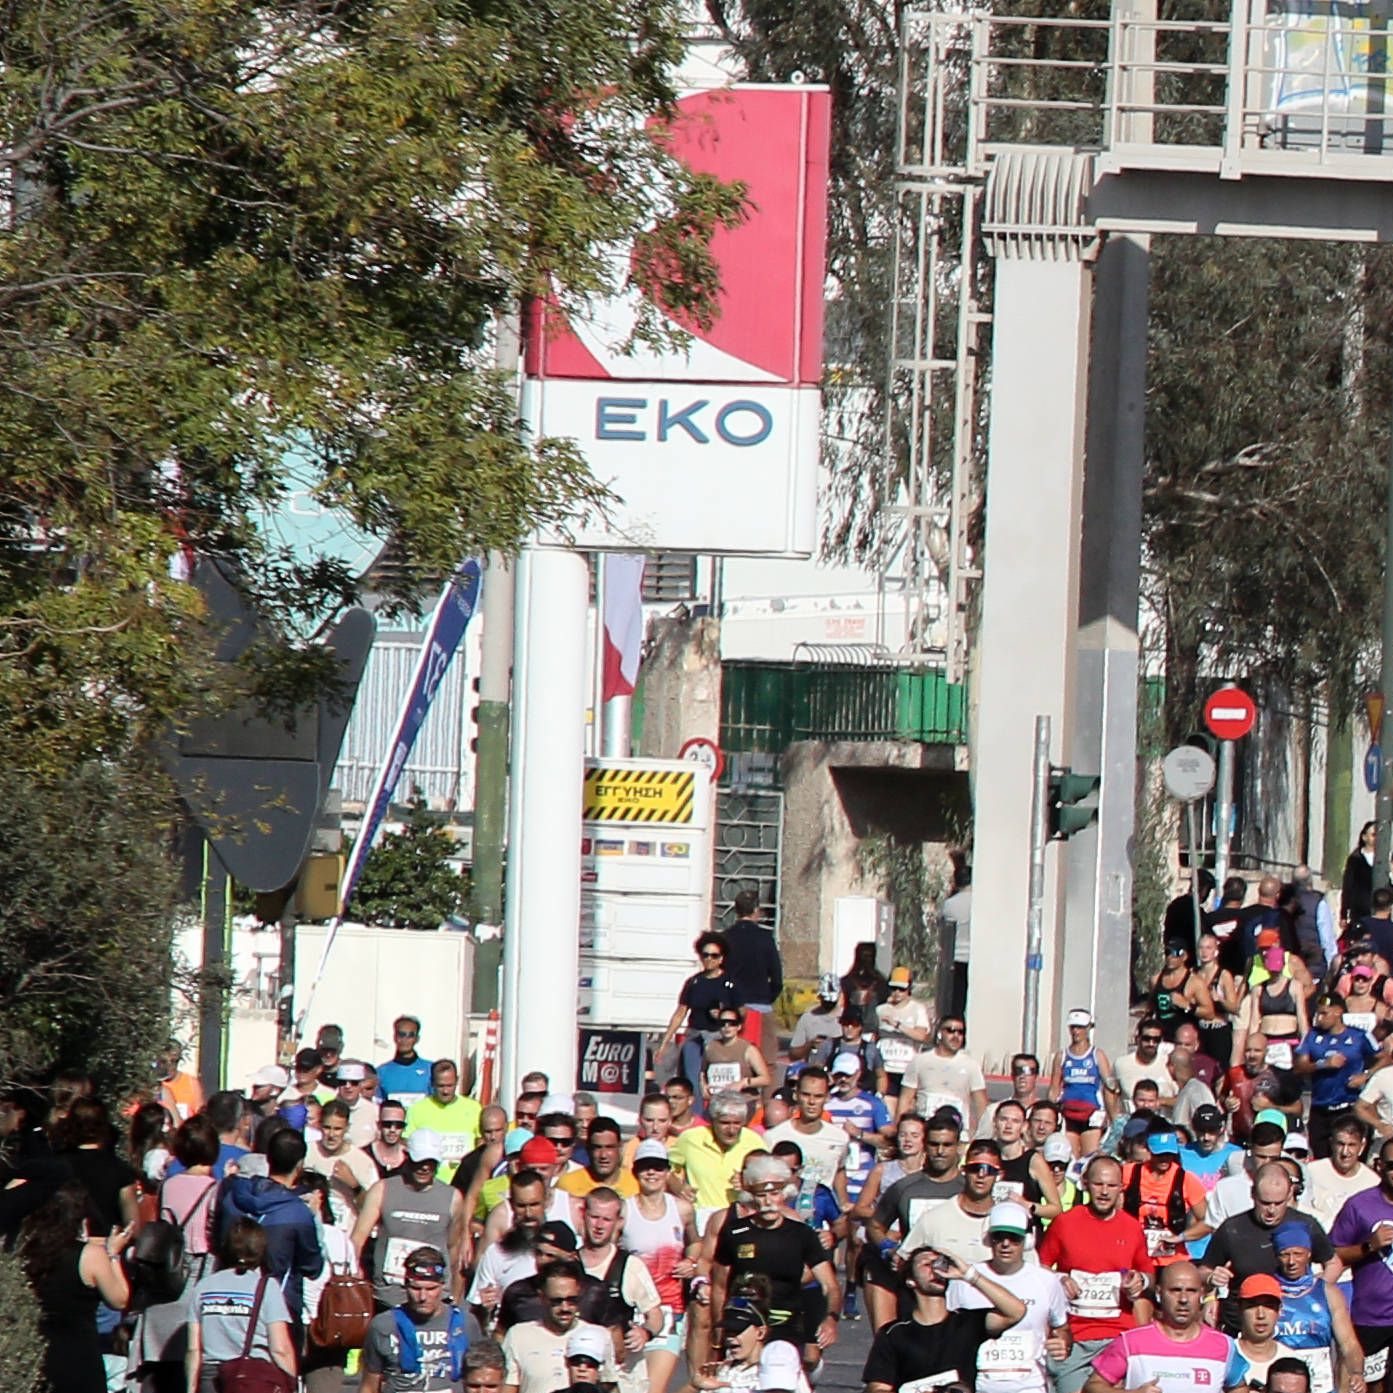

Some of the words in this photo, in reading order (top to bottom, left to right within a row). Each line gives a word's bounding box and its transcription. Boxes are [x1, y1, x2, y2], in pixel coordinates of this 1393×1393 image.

[594, 396, 773, 448] EKO
[594, 784, 664, 799] ΕΓΓΥΗΣΗ
[583, 1034, 634, 1064] EURO
[581, 1061, 630, 1086] M@t
